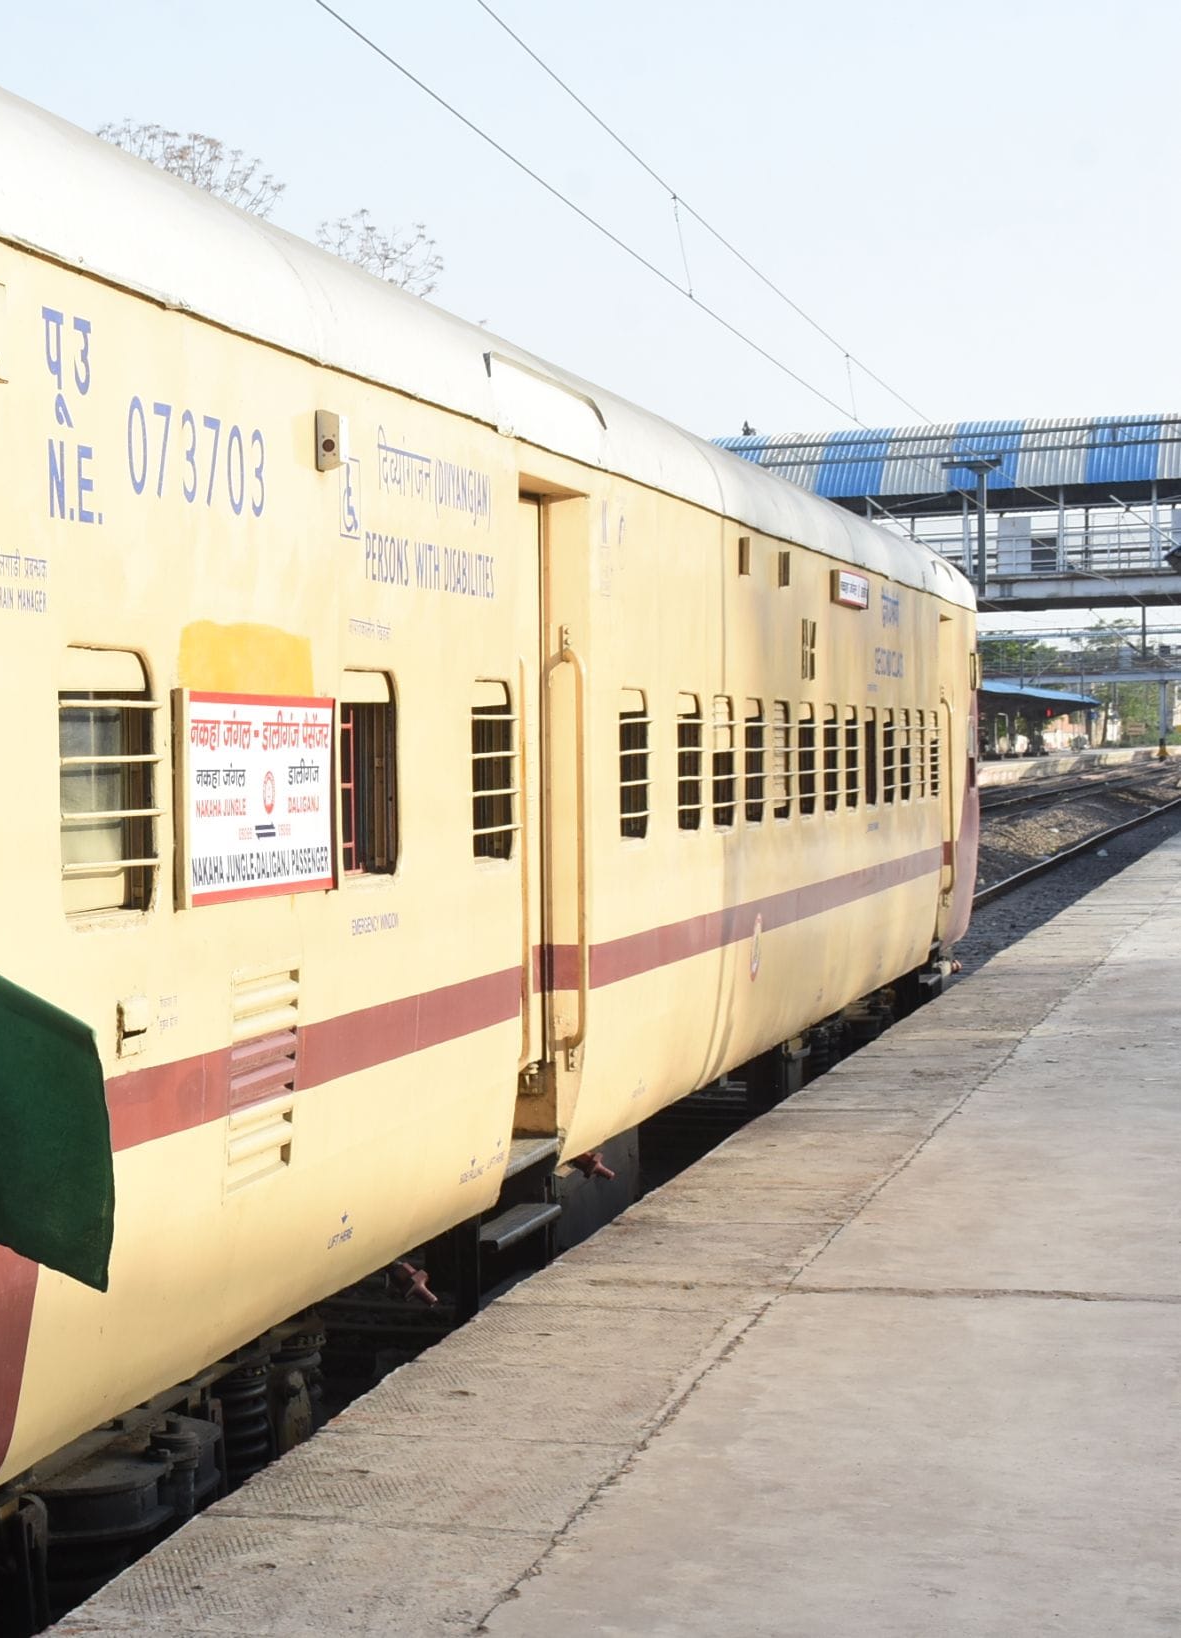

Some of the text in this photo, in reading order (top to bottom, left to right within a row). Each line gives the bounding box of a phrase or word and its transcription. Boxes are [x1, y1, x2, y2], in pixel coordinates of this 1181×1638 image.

[127, 394, 266, 519] 073703
[365, 531, 494, 599] PERSONS WITH DISABILITIES
[17, 589, 47, 613] MANAGER
[190, 719, 221, 751] नकहा
[223, 710, 252, 750] जंगल
[262, 710, 300, 751] डालीगंज
[196, 762, 246, 789] नकहा जंगल
[288, 758, 319, 785] डालीगंज
[195, 798, 246, 818] NAKAHA JUNGLE
[288, 795, 319, 814] DALIGANJ
[192, 855, 224, 887] NAKAHA
[292, 846, 329, 876] PASSENGER
